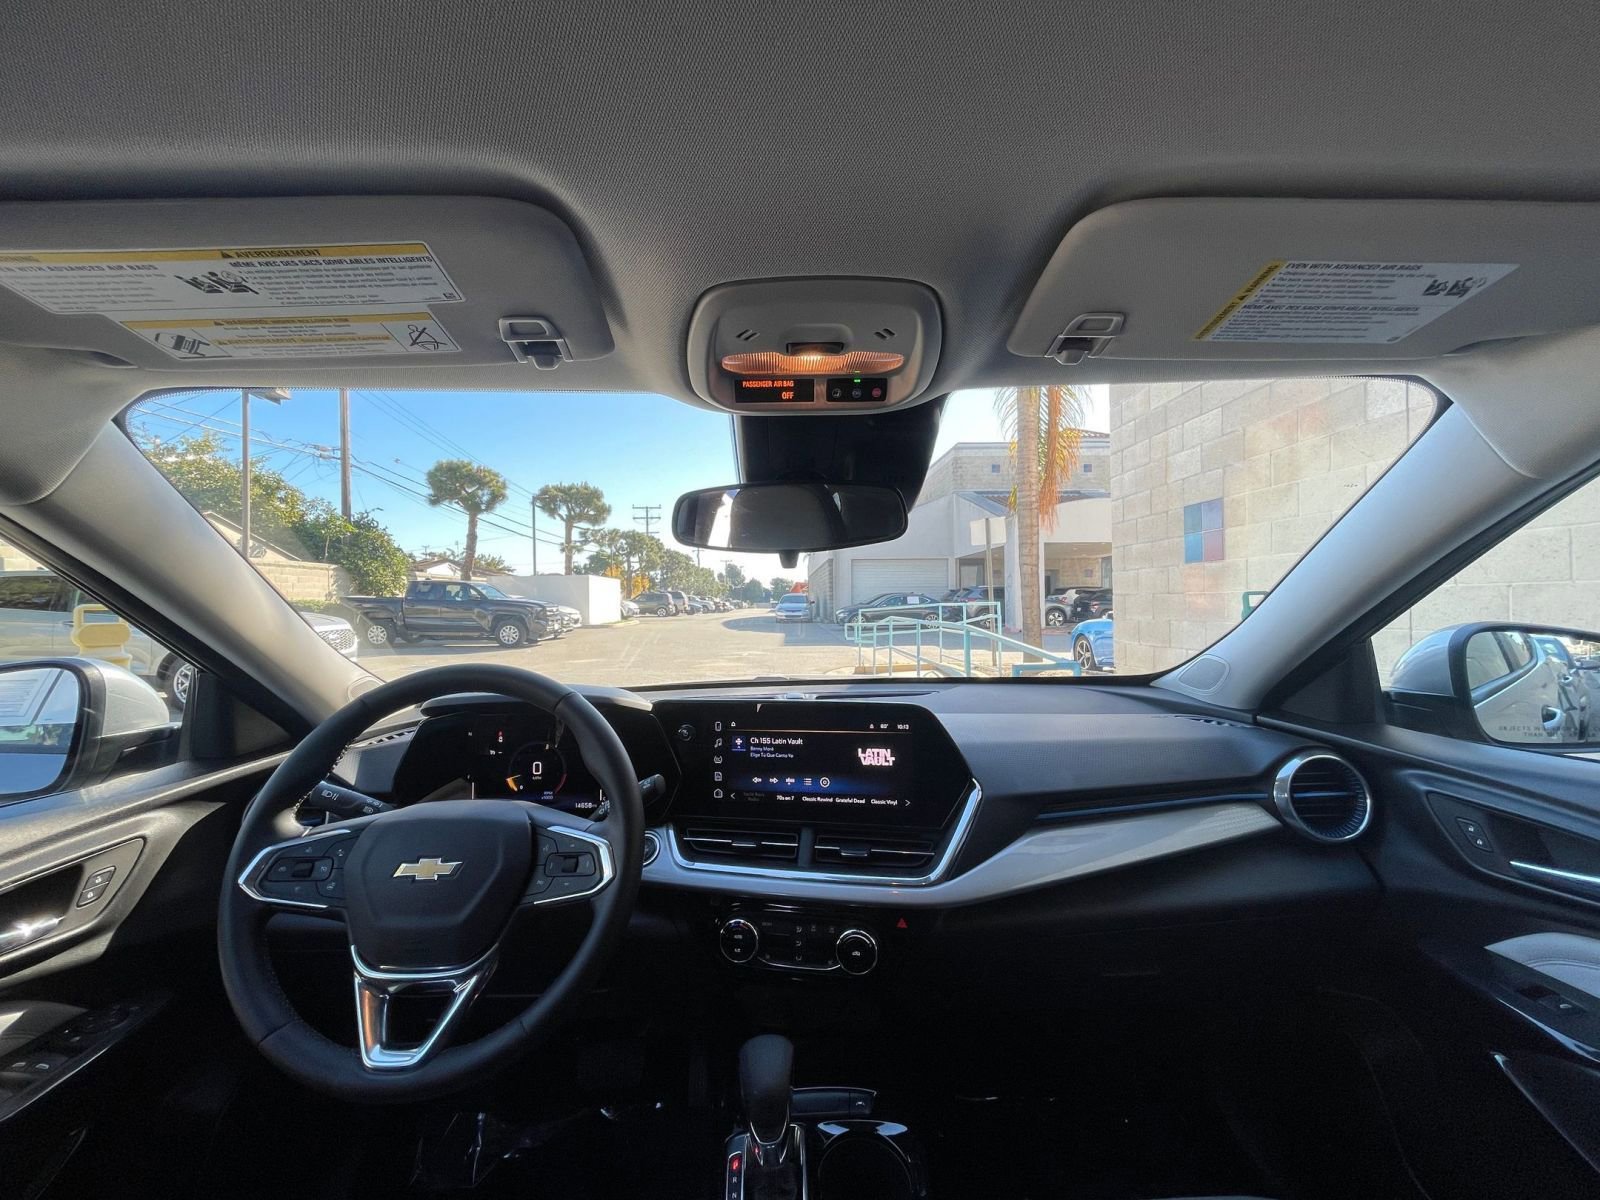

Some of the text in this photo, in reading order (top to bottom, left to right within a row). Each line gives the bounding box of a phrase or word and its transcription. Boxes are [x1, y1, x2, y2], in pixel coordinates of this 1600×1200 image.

[234, 249, 321, 258] AVERTISSEMENT
[322, 258, 376, 266] GONFLABLES
[376, 256, 432, 264] INTELLIGENTS
[1309, 262, 1334, 270] WITH
[742, 380, 773, 388] PASSENGER
[781, 391, 794, 399] OFF
[858, 748, 891, 758] LATIN
[860, 757, 896, 766] VAULT
[532, 761, 542, 775] 0
[733, 1159, 738, 1170] P
